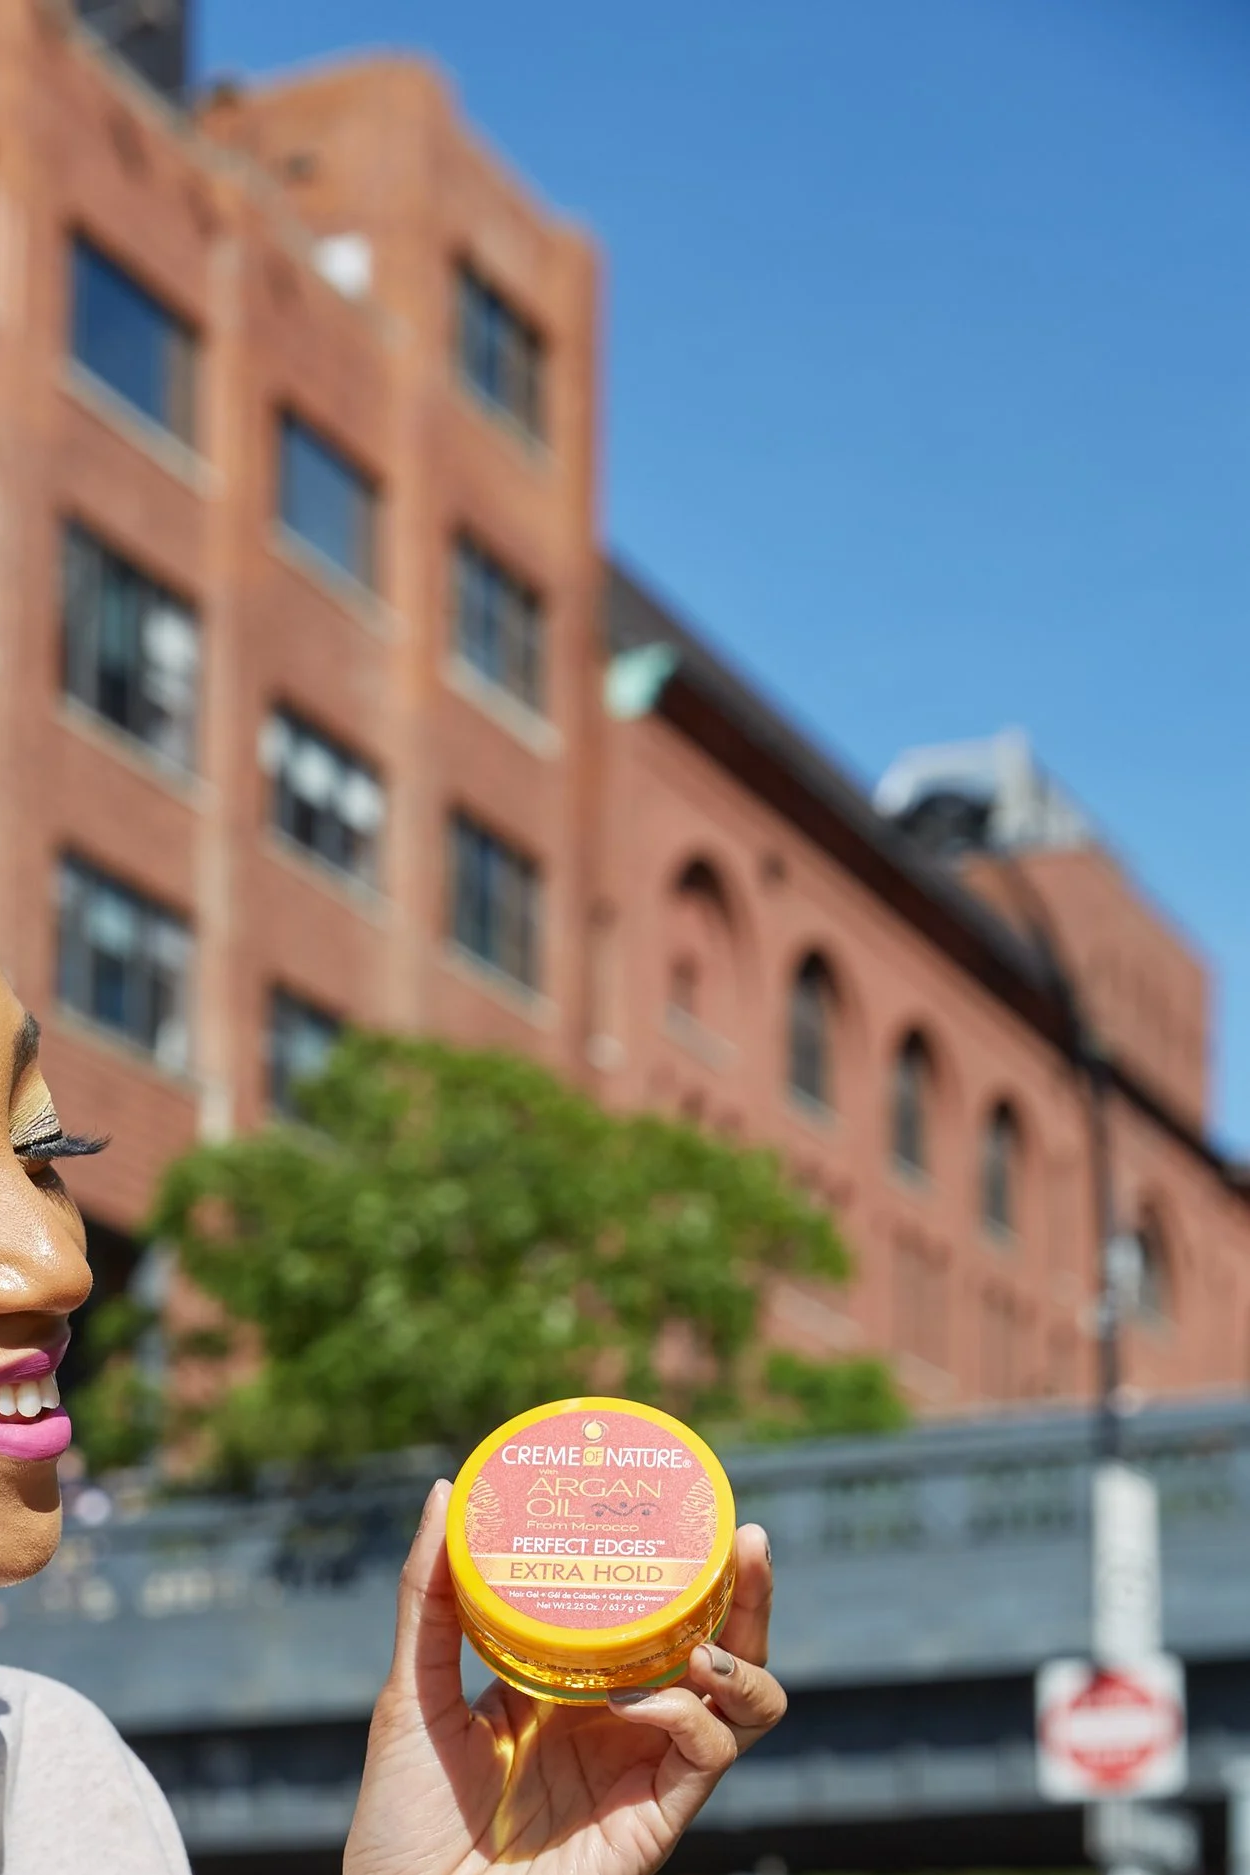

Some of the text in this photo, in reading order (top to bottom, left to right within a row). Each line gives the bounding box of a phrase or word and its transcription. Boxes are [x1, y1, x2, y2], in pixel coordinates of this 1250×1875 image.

[501, 1444, 581, 1466] CREME
[584, 1450, 603, 1463] OF
[527, 1477, 661, 1498] ARGAN
[526, 1497, 585, 1518] OIL
[526, 1520, 640, 1533] From Morocco
[512, 1536, 590, 1555] PERFECT
[509, 1561, 664, 1583] EXTRA HOLD
[509, 1590, 525, 1598] Hair
[525, 1590, 539, 1598] Gel
[561, 1591, 571, 1599] de
[623, 1593, 633, 1601] de
